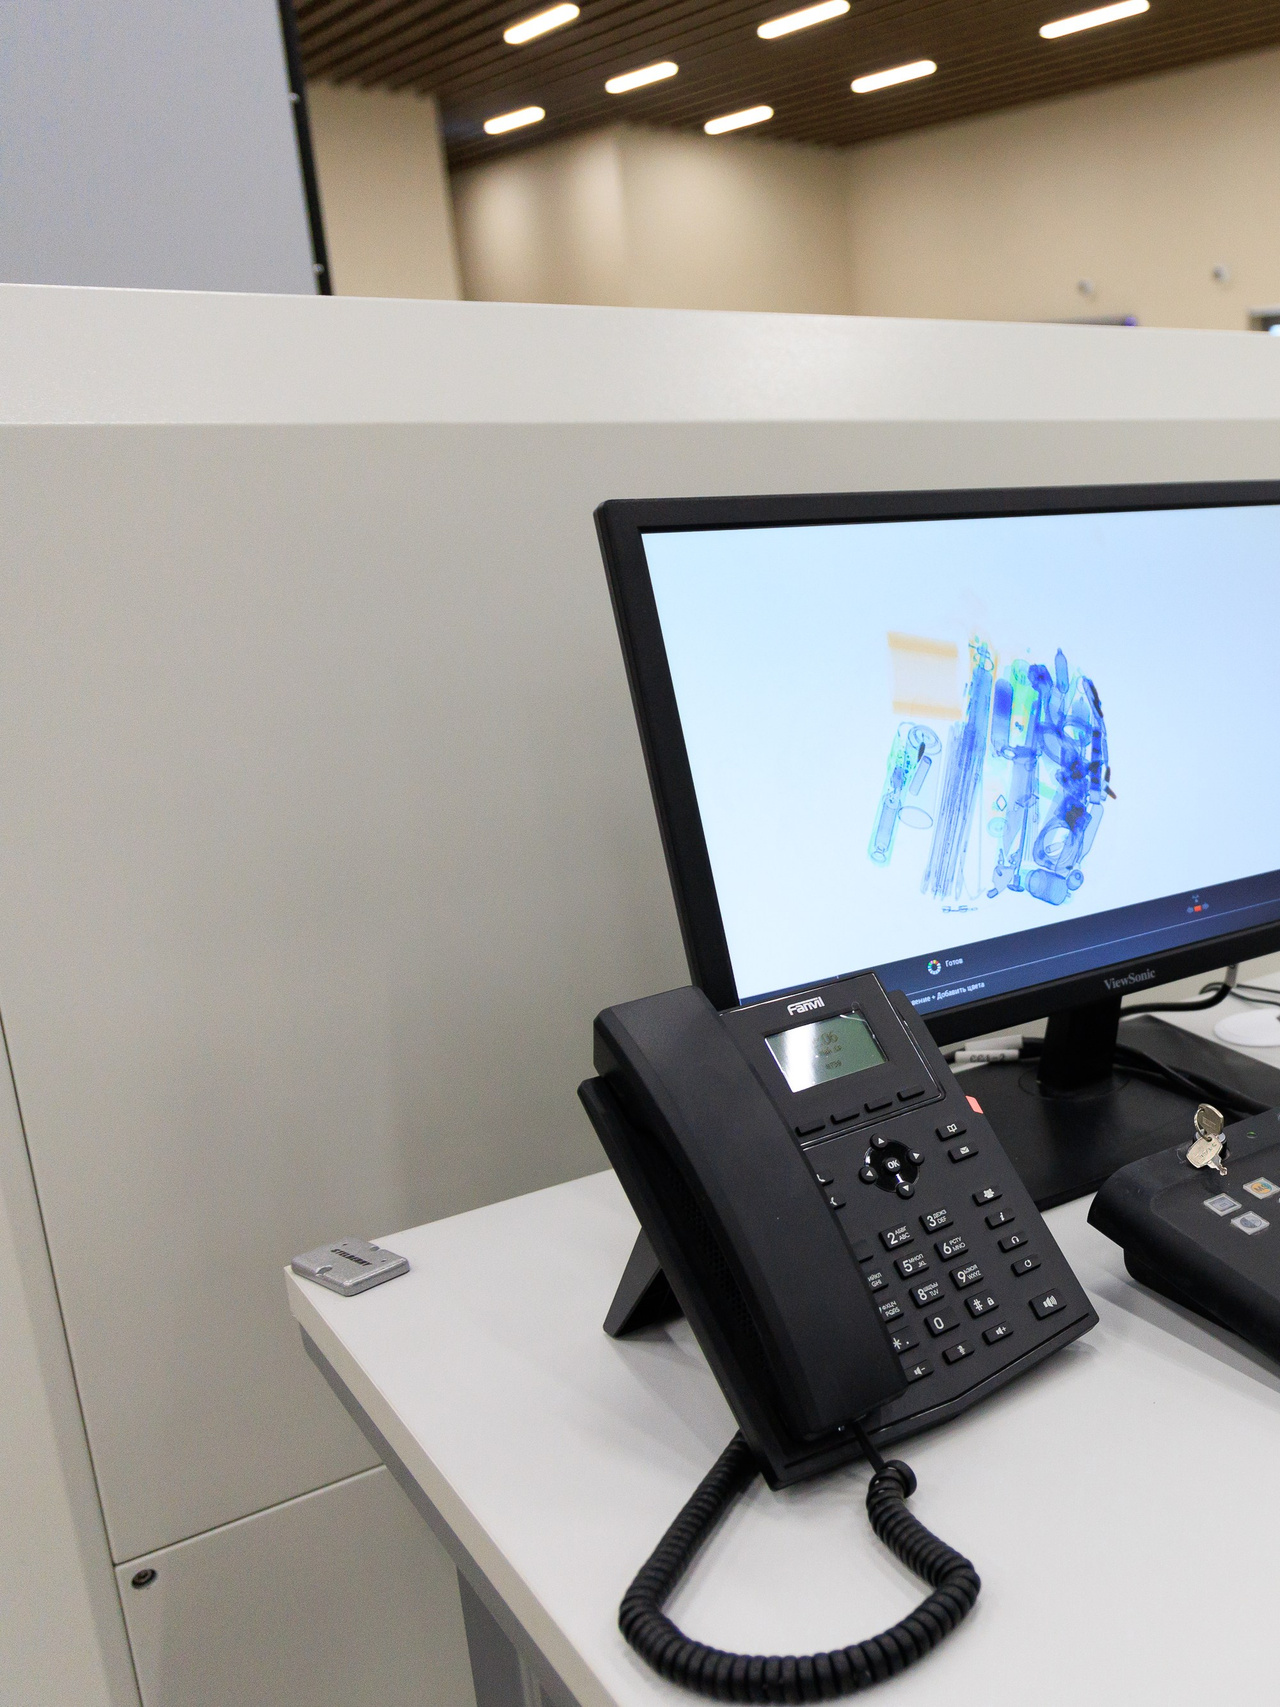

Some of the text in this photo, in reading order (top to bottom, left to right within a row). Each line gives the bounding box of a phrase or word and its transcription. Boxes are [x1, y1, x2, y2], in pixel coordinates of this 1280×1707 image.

[945, 958, 964, 968] Готов
[1104, 968, 1156, 990] ViewSonic
[936, 987, 966, 1001] Добавить
[967, 981, 986, 993] цвета
[786, 996, 826, 1016] Fanvil
[887, 1158, 901, 1170] OK
[926, 1215, 937, 1227] 3
[887, 1232, 899, 1245] 2
[898, 1232, 911, 1241] ABC
[943, 1242, 952, 1255] 6
[952, 1242, 966, 1252] MNO
[902, 1259, 913, 1272] 5
[957, 1271, 966, 1283] 9
[917, 1288, 928, 1300] 8
[933, 1316, 945, 1330] 0
